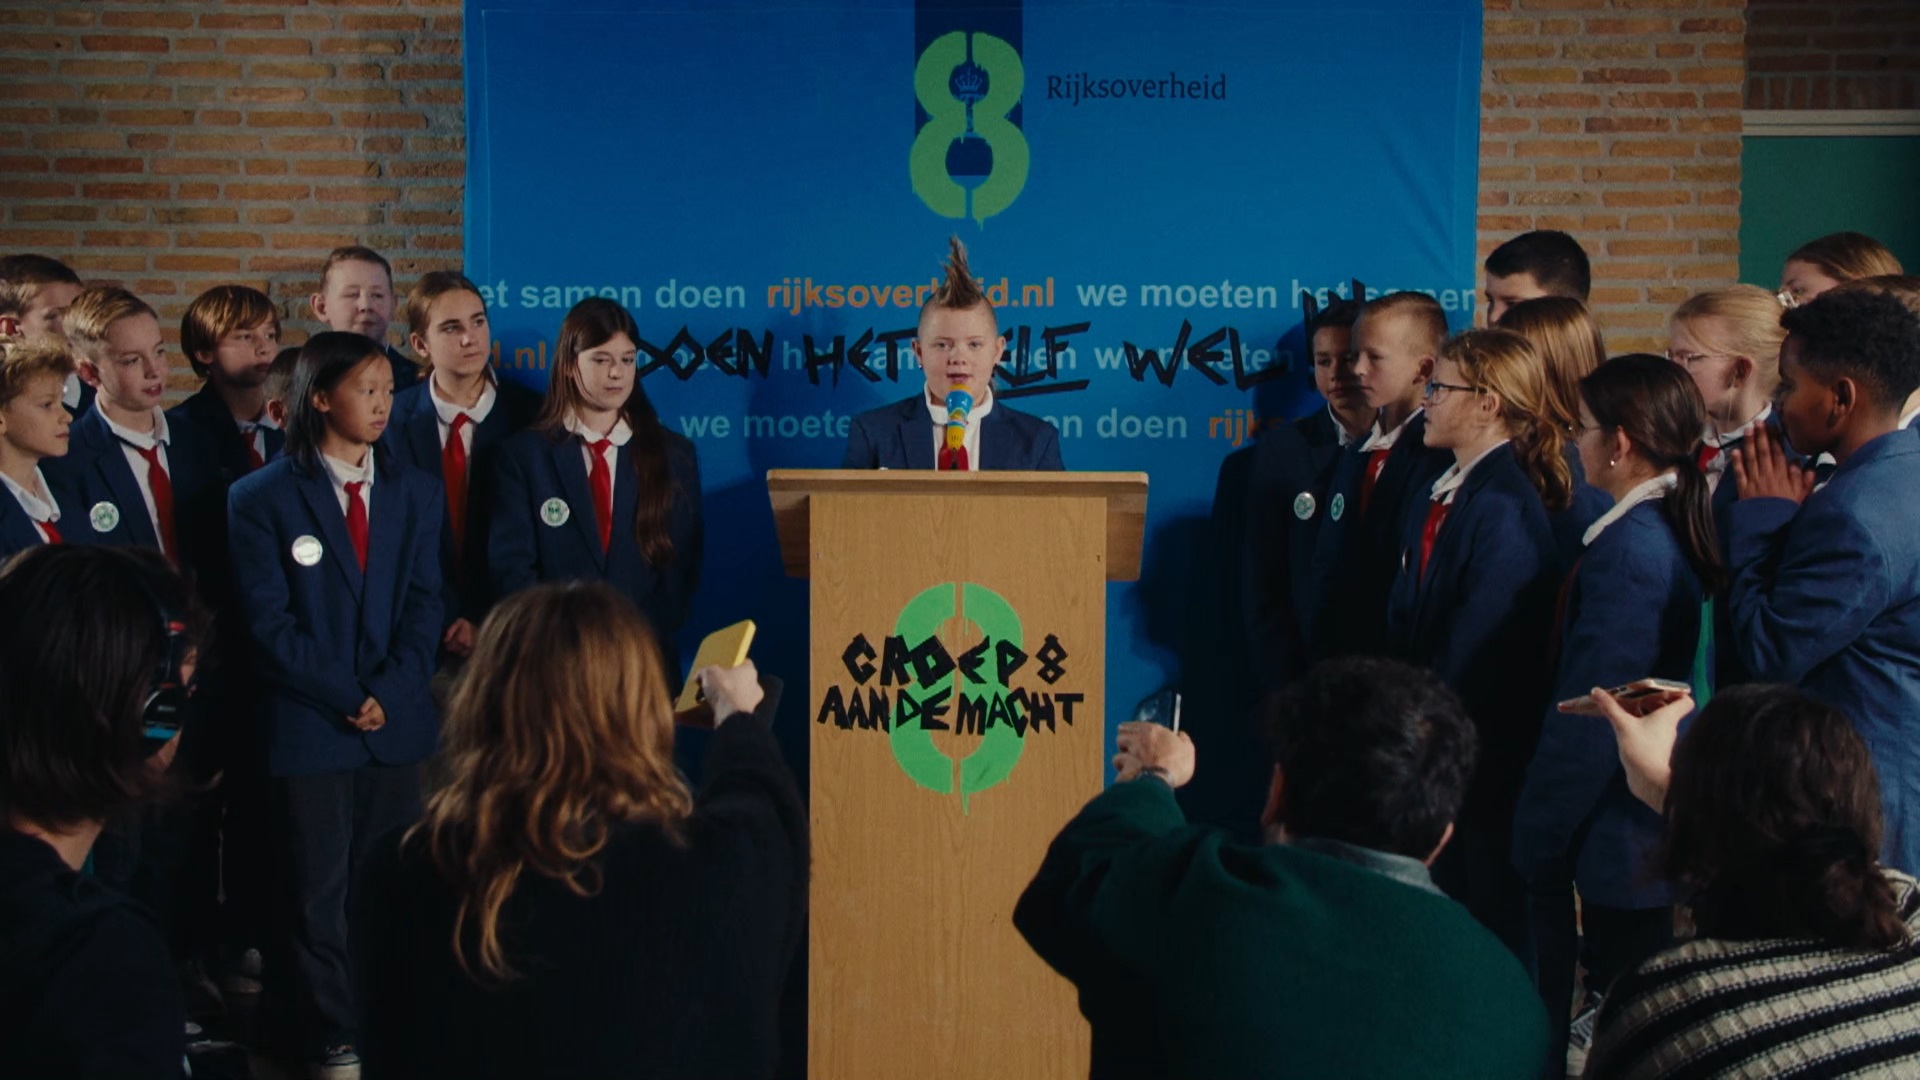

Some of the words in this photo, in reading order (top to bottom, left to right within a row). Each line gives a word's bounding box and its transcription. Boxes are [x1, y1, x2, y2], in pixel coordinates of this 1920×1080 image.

[1046, 72, 1227, 106] Rijksoverheid
[479, 280, 508, 308] et
[655, 279, 746, 309] doen
[1077, 284, 1128, 308] we
[1140, 279, 1277, 309] moeten
[803, 327, 918, 388] HET
[994, 321, 1091, 388] ELF
[1123, 318, 1290, 391] WEL
[680, 414, 730, 438] we
[743, 409, 850, 438] moete
[1096, 407, 1187, 439] doen
[841, 633, 1029, 690] GROEP
[1036, 634, 1068, 685] 8
